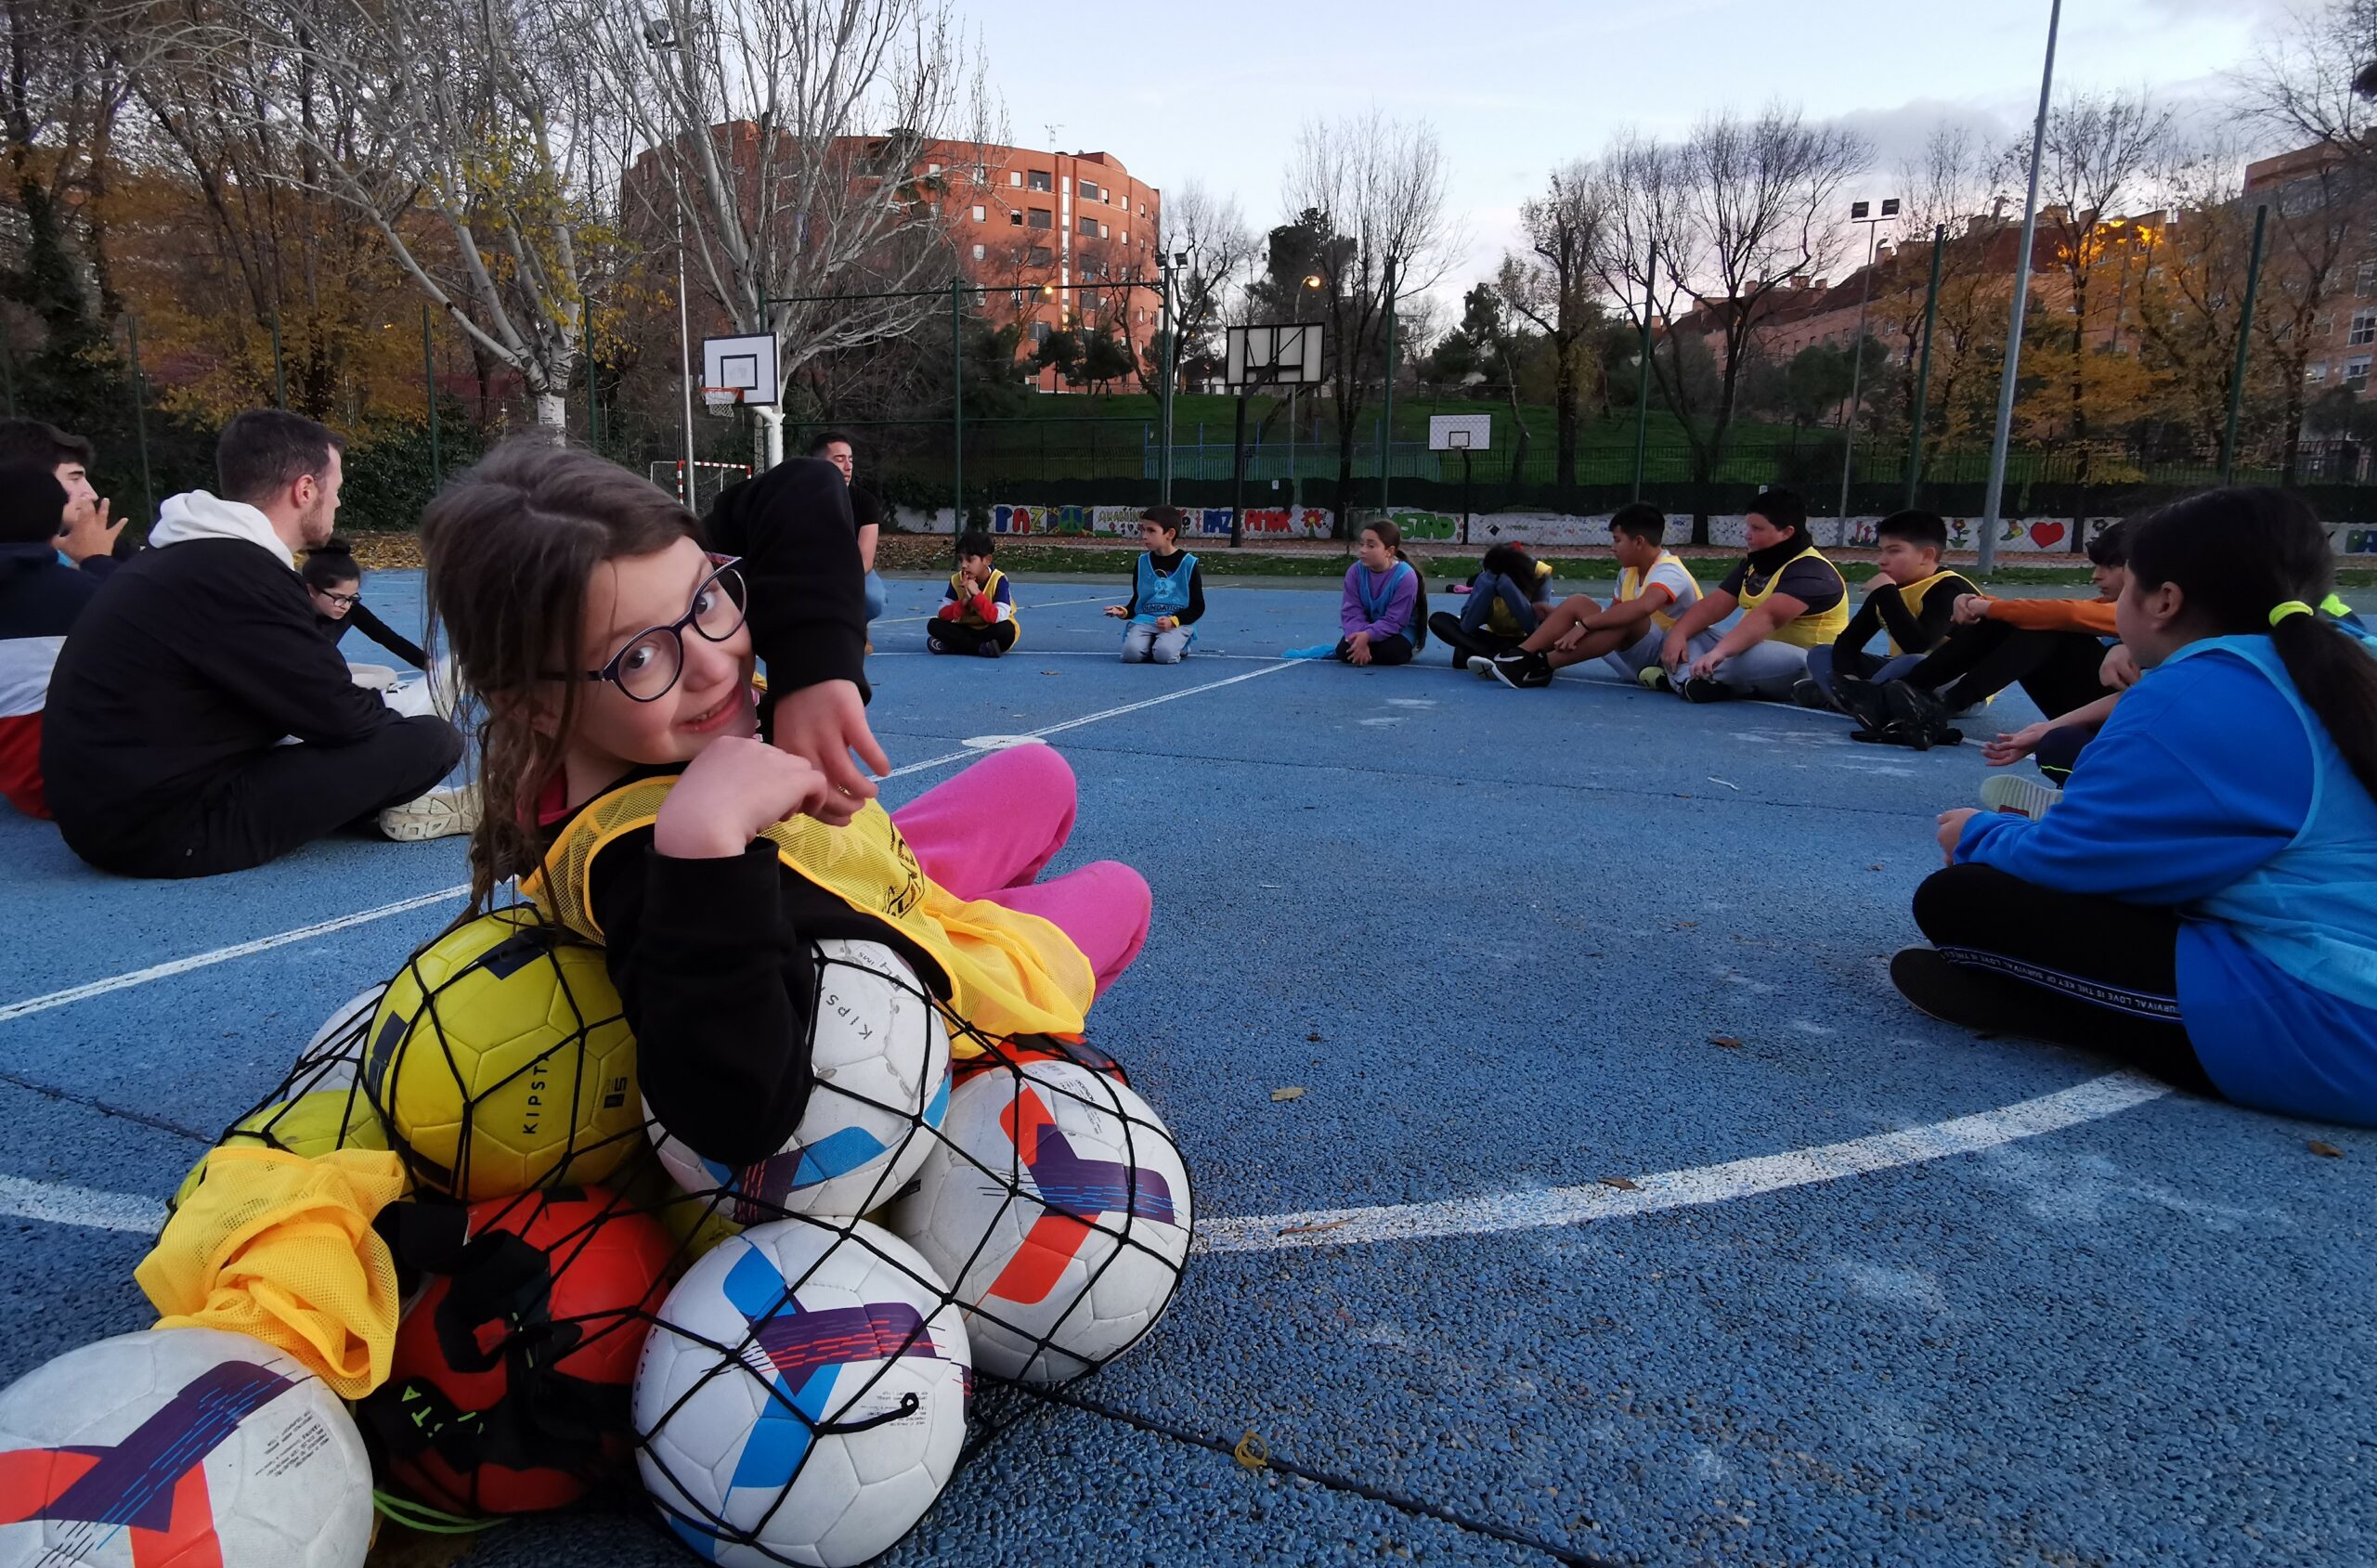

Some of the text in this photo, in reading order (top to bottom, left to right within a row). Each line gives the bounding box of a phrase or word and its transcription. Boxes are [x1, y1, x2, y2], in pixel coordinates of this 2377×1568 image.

[995, 506, 1046, 535] PAZ
[1203, 510, 1233, 534] PAZ
[1981, 954, 2001, 966] LOVE
[2059, 978, 2075, 989] KEY
[2077, 984, 2094, 995] THE
[2097, 990, 2105, 998] IS
[2108, 993, 2131, 1005] LOVE
